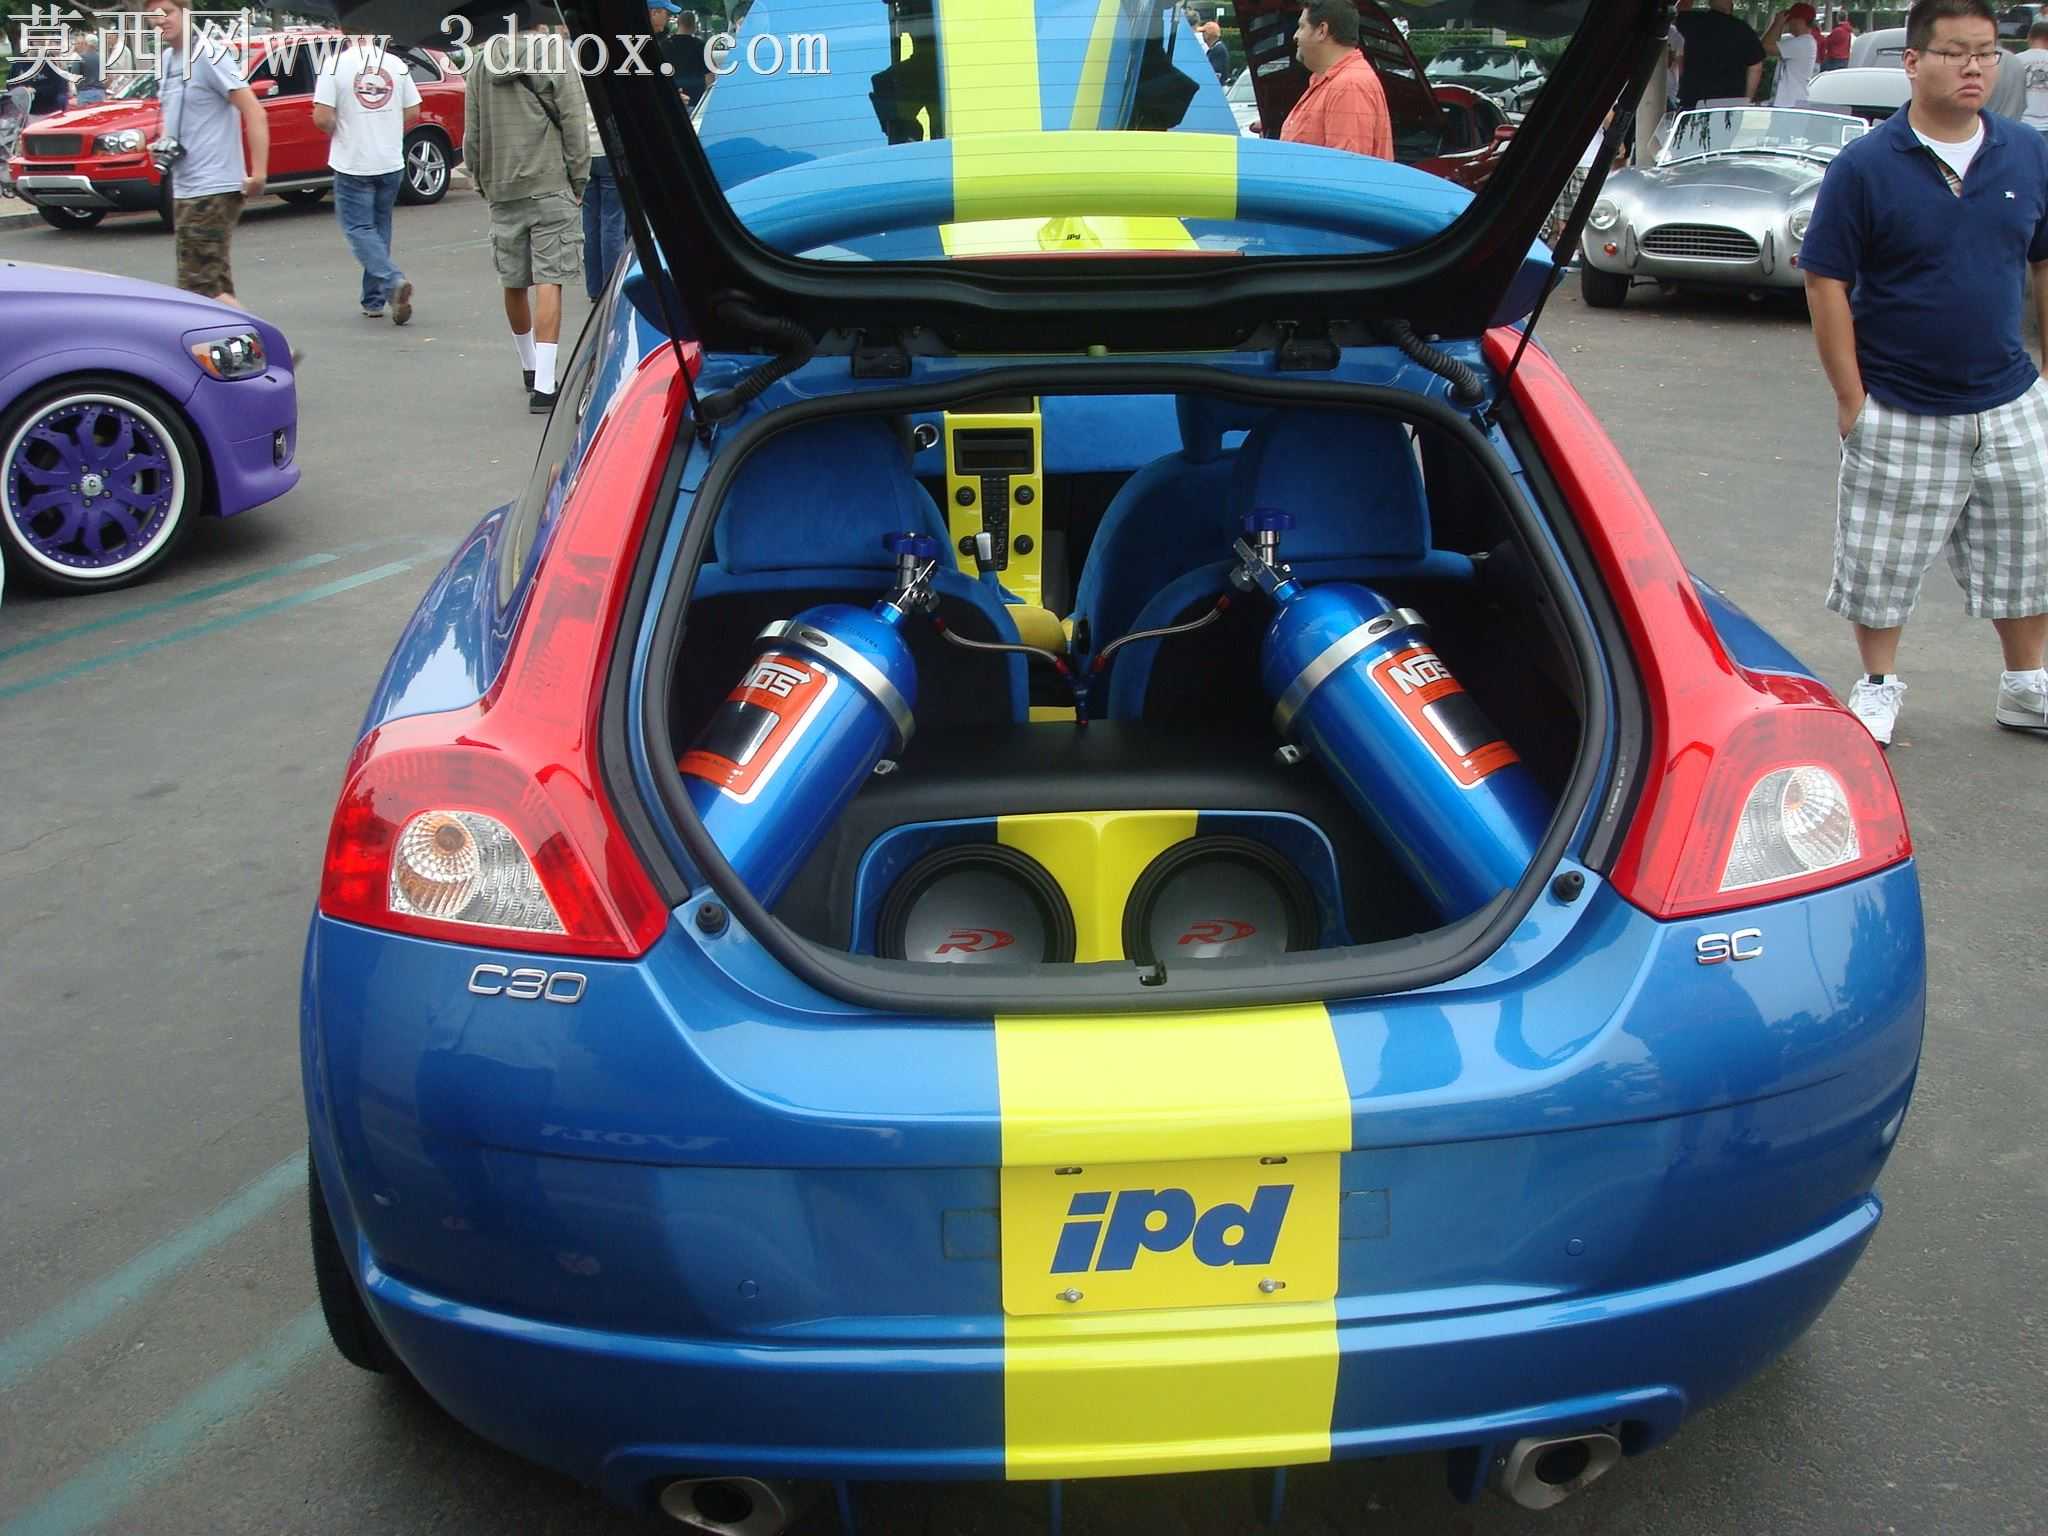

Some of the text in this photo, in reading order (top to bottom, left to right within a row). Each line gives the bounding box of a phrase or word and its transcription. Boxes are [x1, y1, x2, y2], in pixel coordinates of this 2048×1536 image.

[1387, 652, 1454, 696] NOS
[1696, 926, 1764, 966] SC
[468, 963, 588, 1004] C30
[1049, 1184, 1295, 1275] ipd
